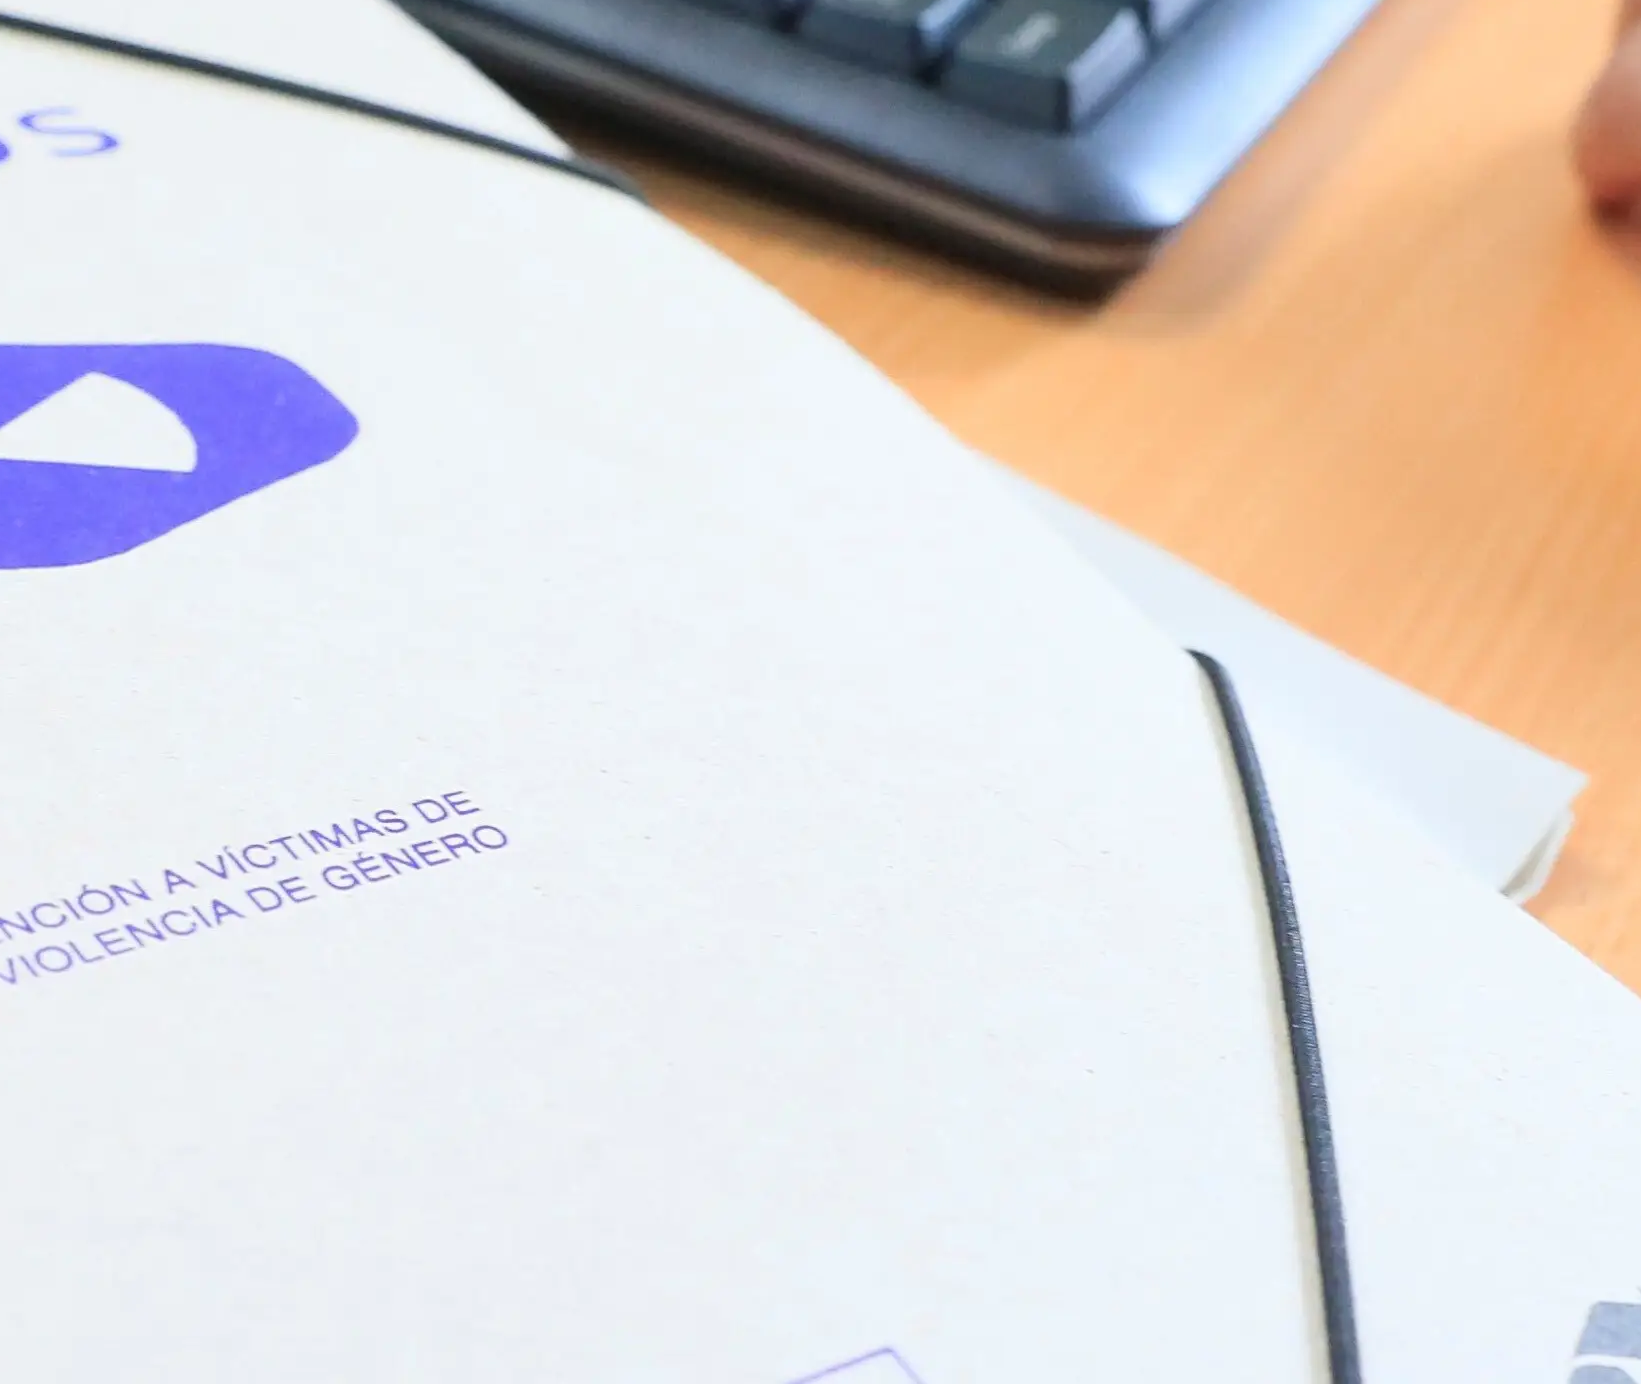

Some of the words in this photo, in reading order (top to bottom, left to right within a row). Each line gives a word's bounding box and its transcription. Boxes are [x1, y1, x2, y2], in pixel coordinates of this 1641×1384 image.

[162, 868, 197, 894] A
[196, 809, 410, 881] VÍCTIMAS
[412, 790, 482, 825] DE
[245, 876, 317, 913] DE
[321, 823, 511, 892] GÉNERO
